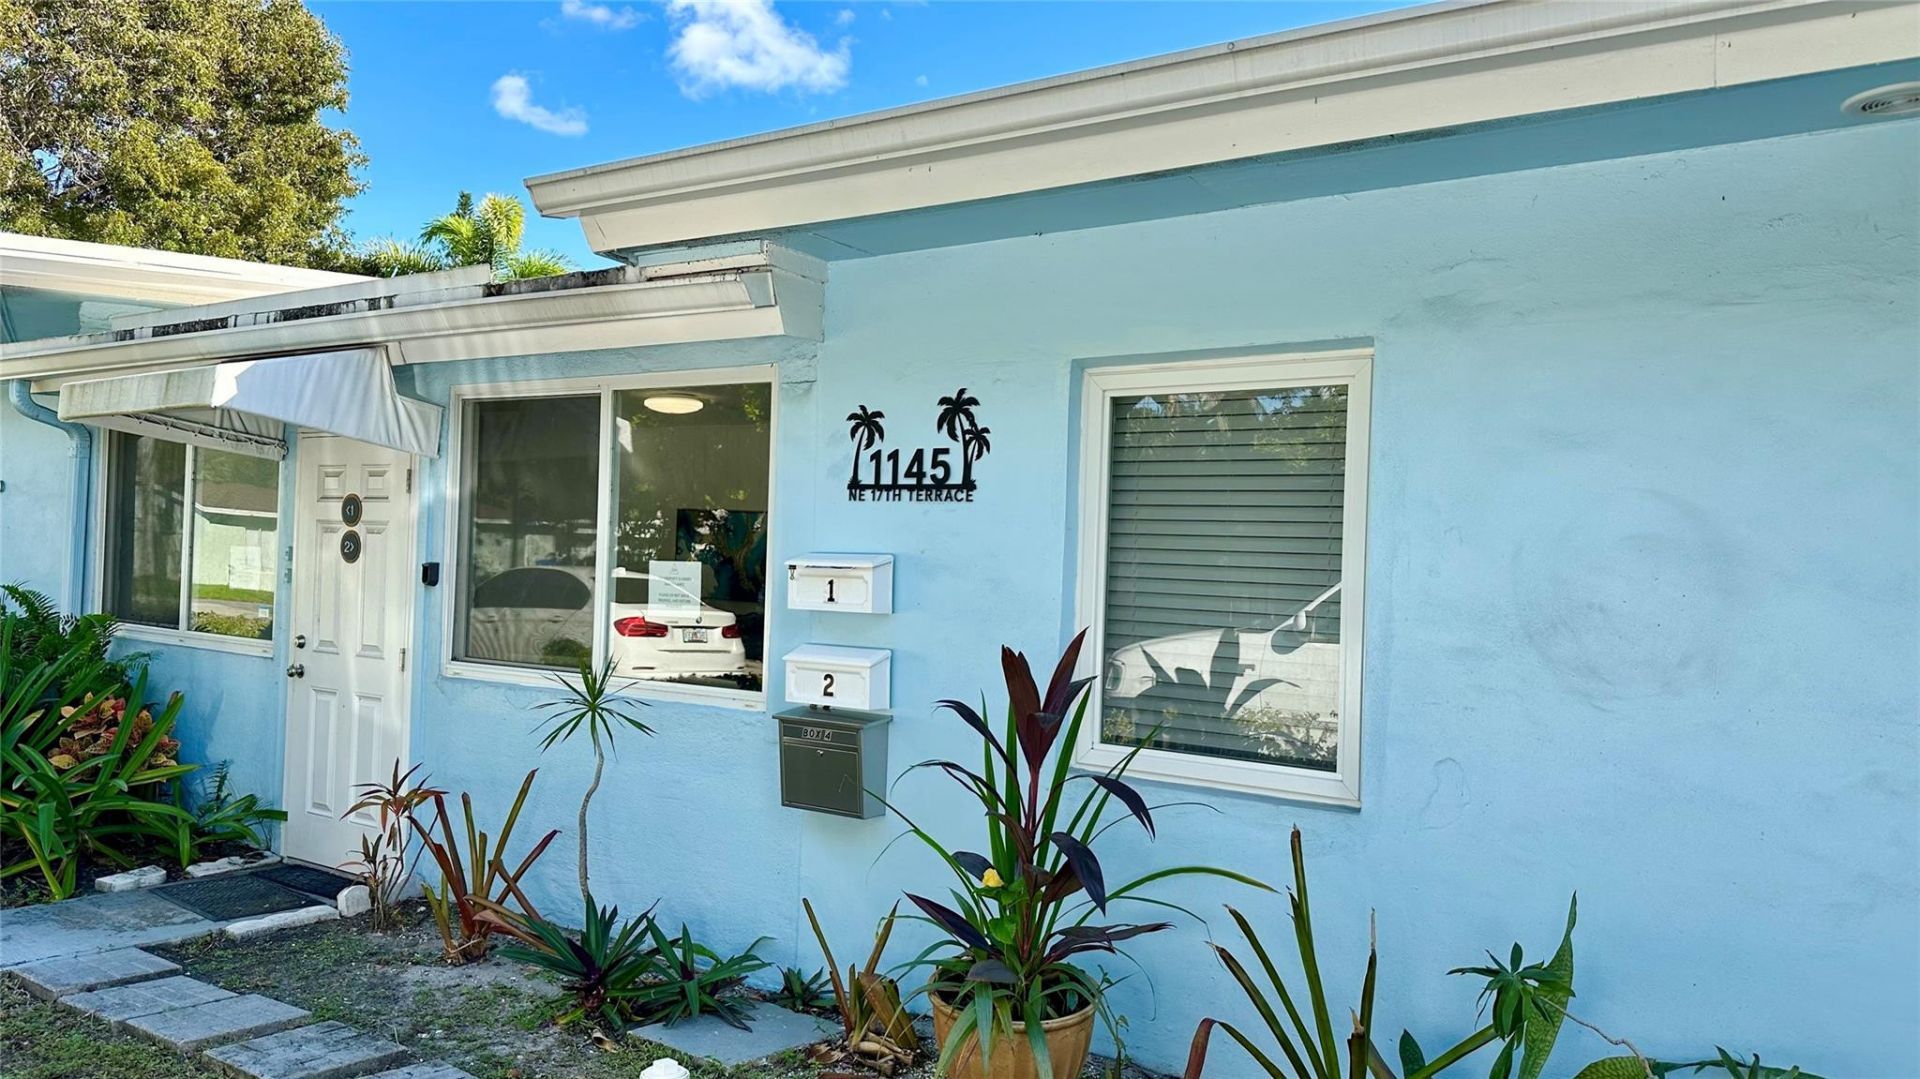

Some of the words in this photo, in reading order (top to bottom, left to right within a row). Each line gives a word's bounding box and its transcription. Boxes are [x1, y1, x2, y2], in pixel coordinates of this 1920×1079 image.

[869, 447, 951, 487] 1145
[848, 488, 866, 502] NE
[871, 488, 901, 502] 17TH
[908, 489, 974, 503] TERRACE
[826, 578, 836, 603] 1
[822, 673, 835, 697] 2
[802, 728, 821, 739] BOX
[824, 730, 832, 741] 4
